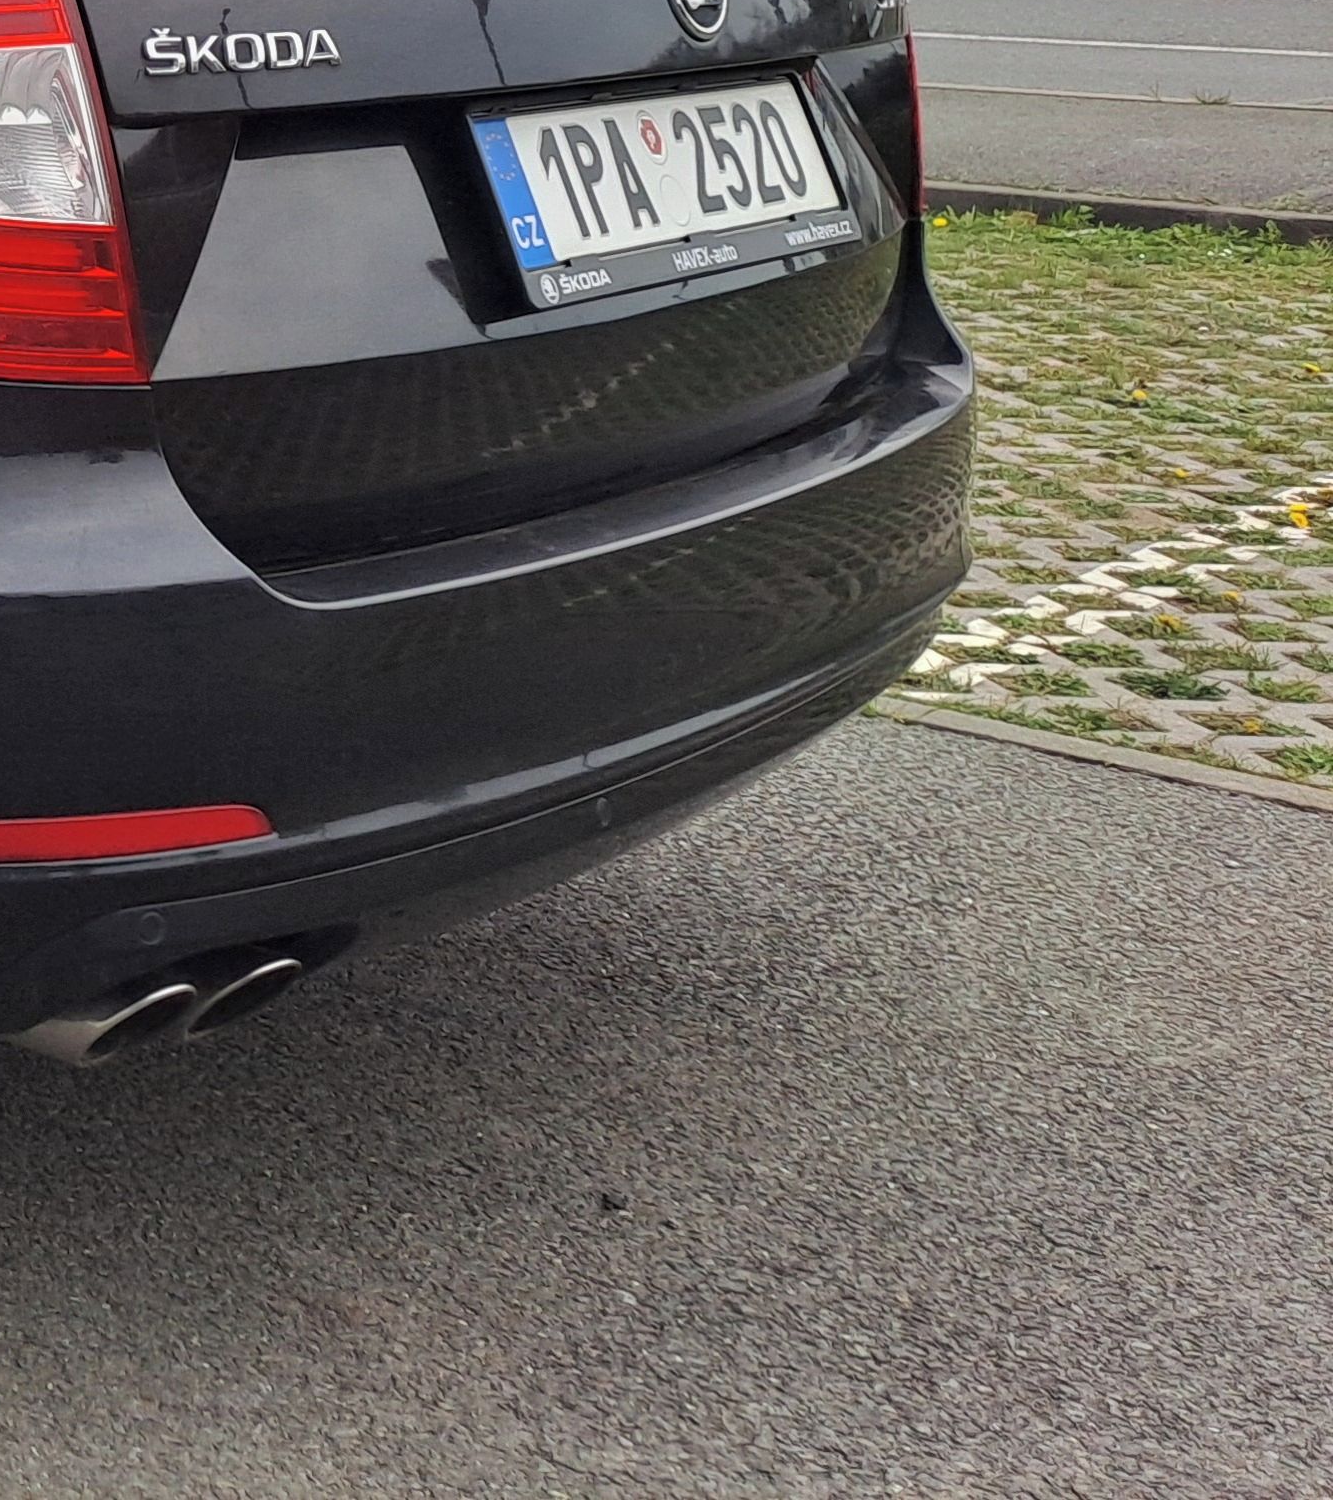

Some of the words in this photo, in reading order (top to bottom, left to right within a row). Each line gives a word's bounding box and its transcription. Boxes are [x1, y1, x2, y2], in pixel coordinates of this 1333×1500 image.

[144, 27, 342, 76] ŠKODA
[538, 118, 661, 240] 1PA
[672, 100, 808, 214] 2520
[511, 213, 546, 250] CZ
[784, 218, 854, 248] www.havex.cz
[671, 243, 739, 272] HAVEX-auto
[560, 268, 612, 296] ŠKODA
